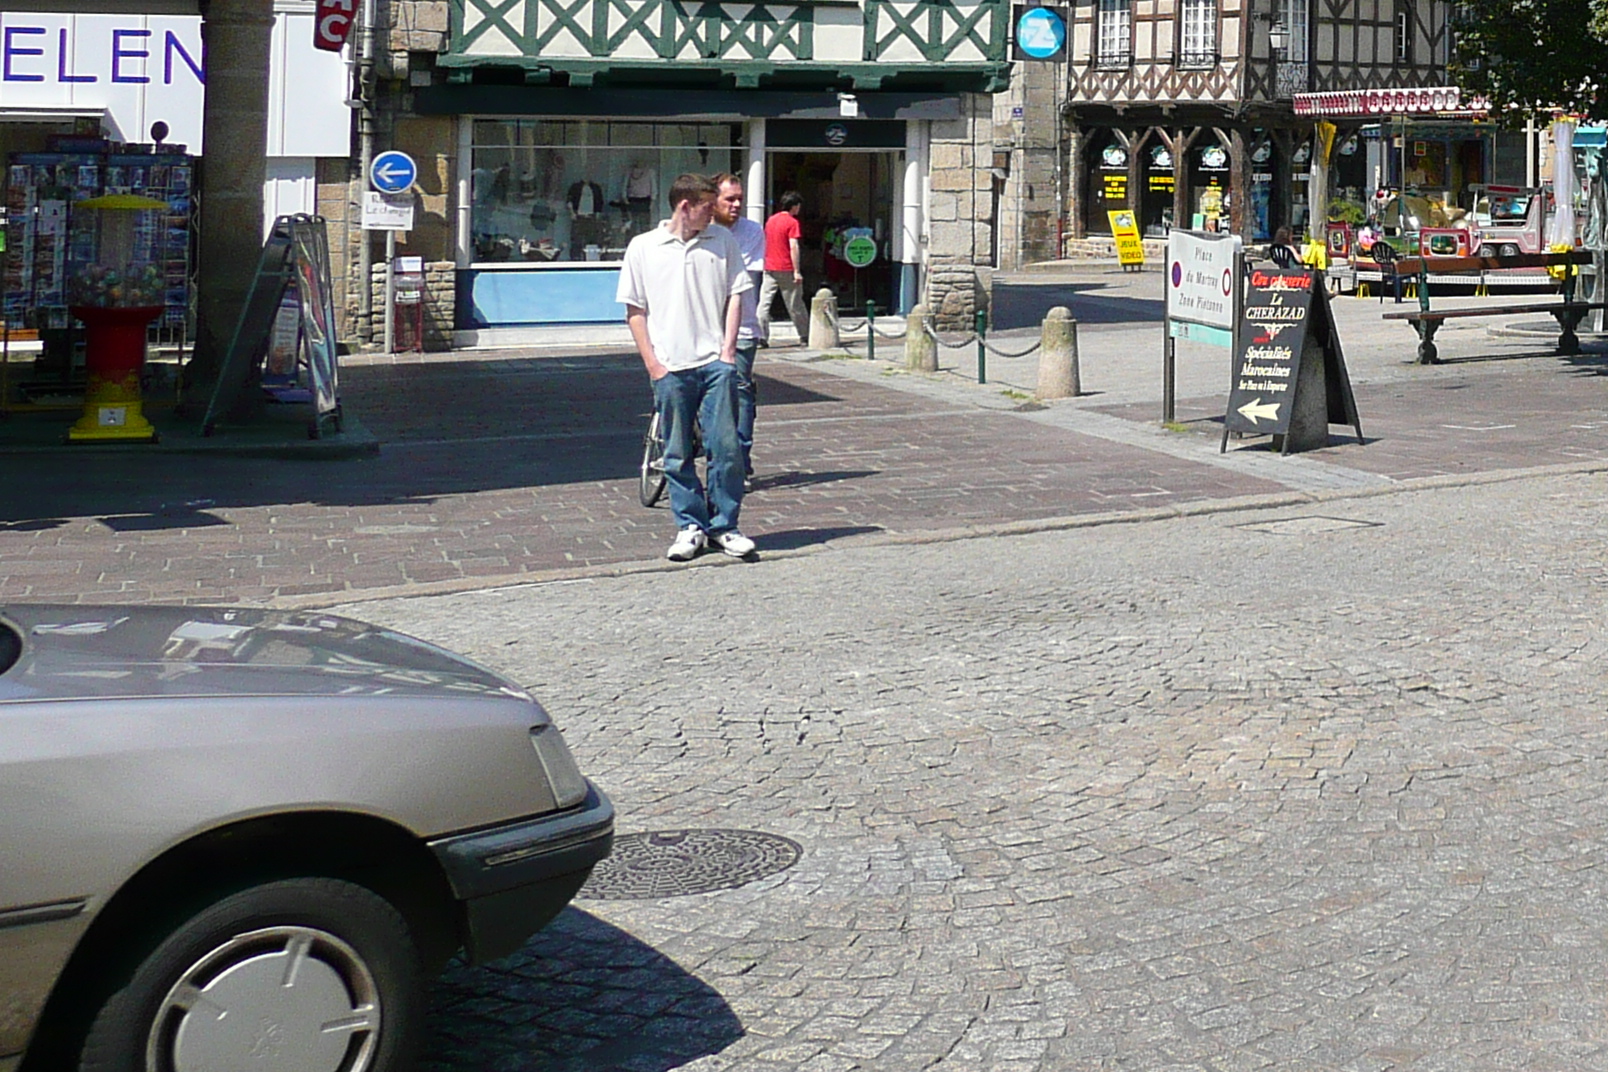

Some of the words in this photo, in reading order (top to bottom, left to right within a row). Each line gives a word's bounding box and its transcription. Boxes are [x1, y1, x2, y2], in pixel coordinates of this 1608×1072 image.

[1120, 240, 1138, 248] JEUX
[1121, 251, 1142, 260] VIDEO
[1195, 246, 1213, 262] Place
[1186, 269, 1194, 283] du
[1179, 292, 1194, 308] Zone
[1246, 306, 1306, 320] CHERAZAD
[1244, 345, 1292, 363] Spécialités
[1240, 362, 1291, 377] Marocaines
